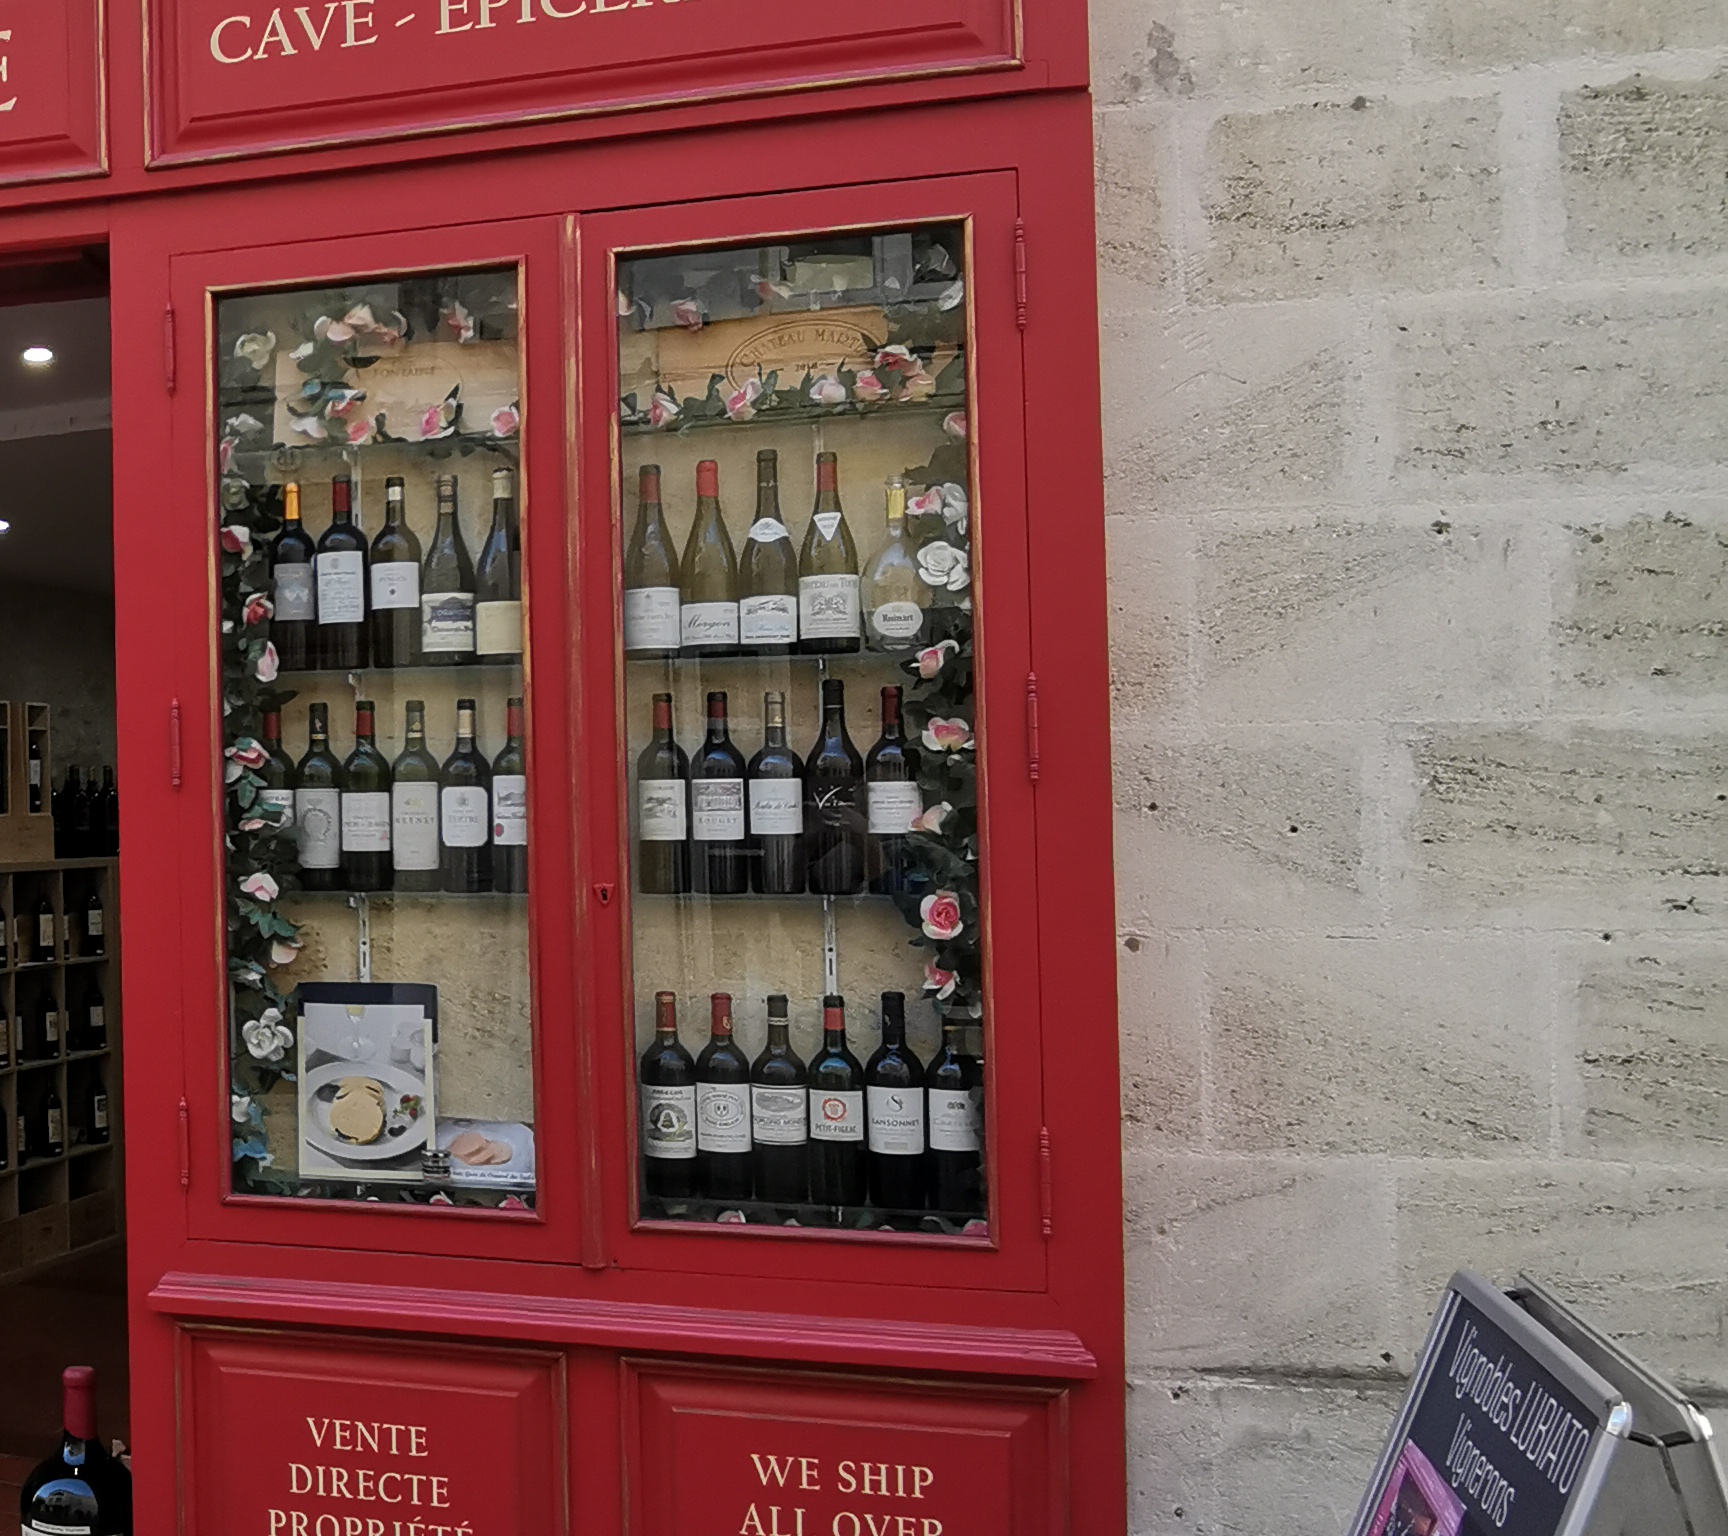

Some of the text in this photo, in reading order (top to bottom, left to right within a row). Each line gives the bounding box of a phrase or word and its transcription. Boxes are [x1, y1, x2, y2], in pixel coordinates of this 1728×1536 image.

[1449, 1320, 1589, 1493] Vignobles LUBIATO
[306, 1417, 429, 1457] VENTE
[288, 1462, 450, 1508] DIRECTE
[750, 1453, 935, 1500] WE SHIP
[1446, 1413, 1515, 1527] Vignerons
